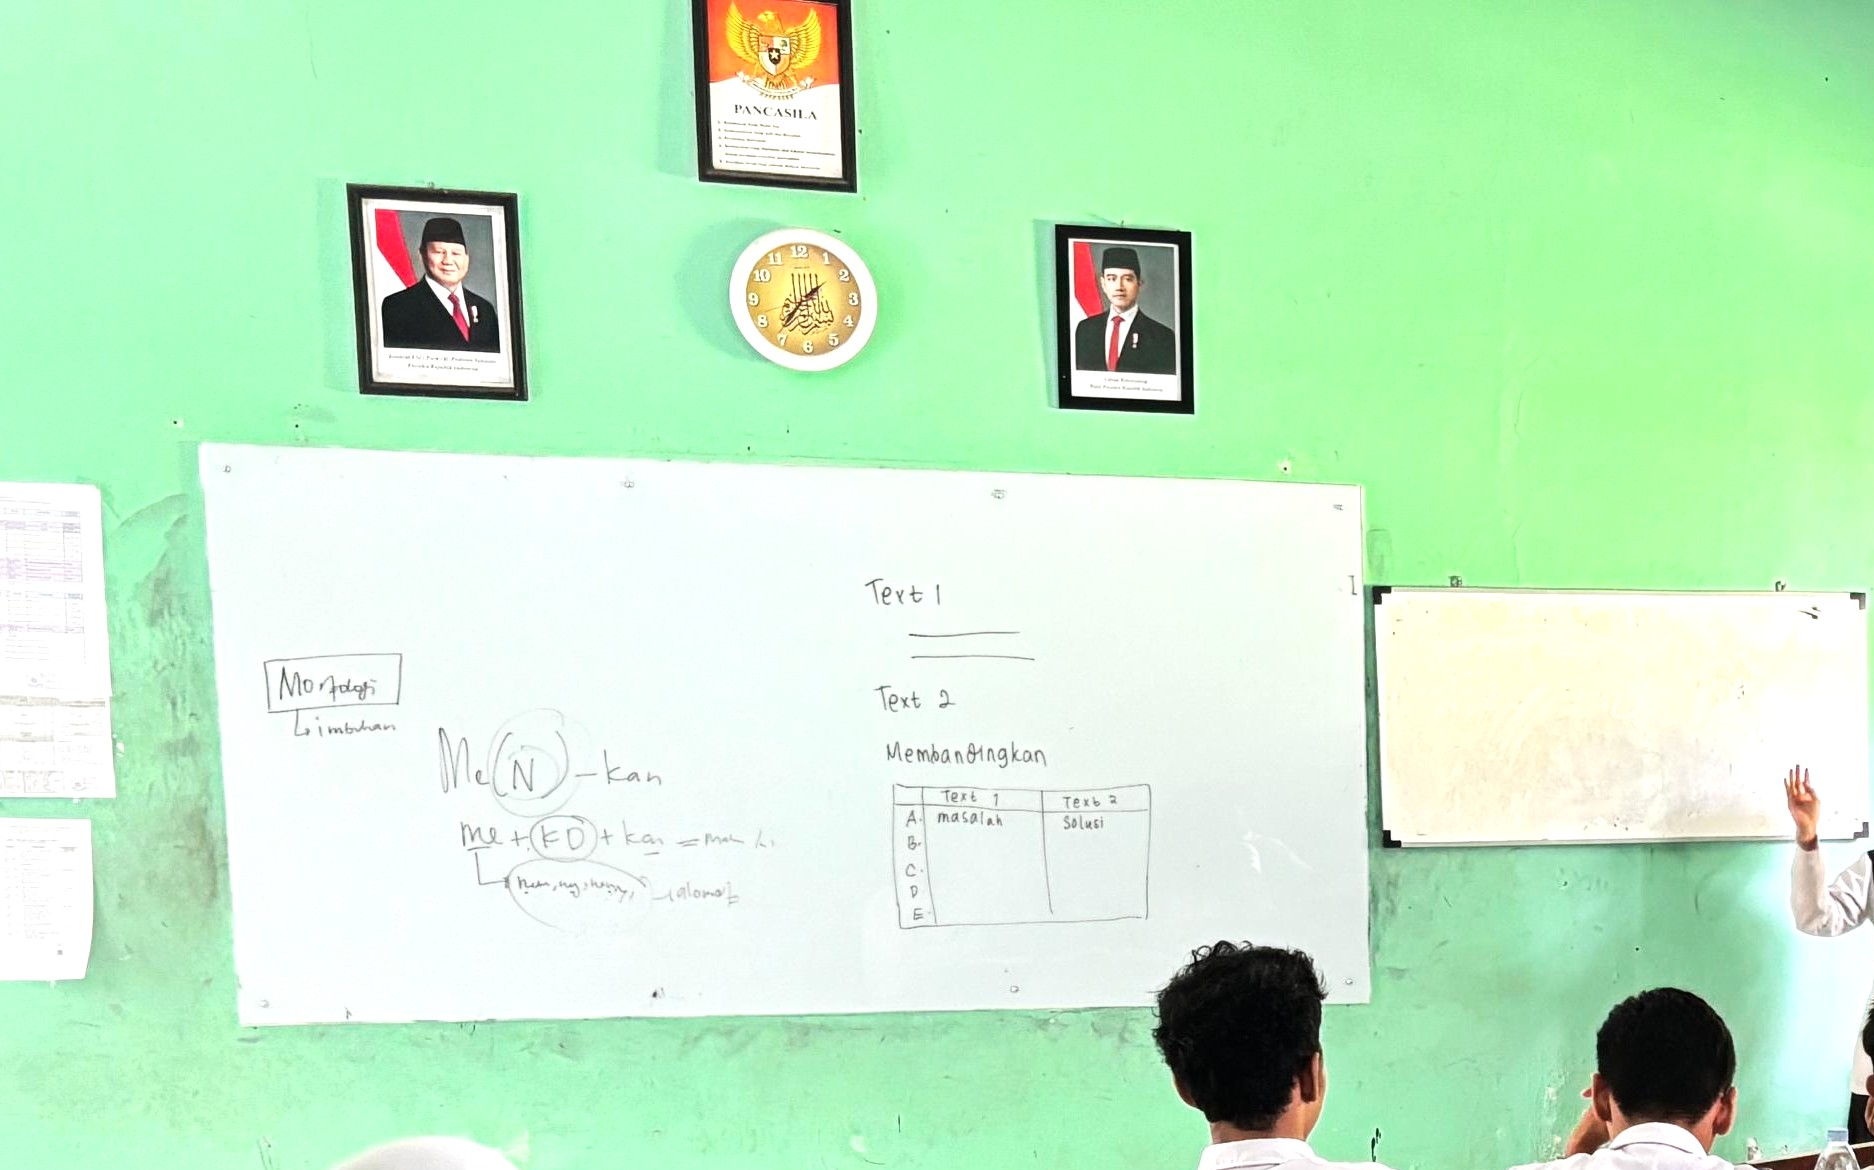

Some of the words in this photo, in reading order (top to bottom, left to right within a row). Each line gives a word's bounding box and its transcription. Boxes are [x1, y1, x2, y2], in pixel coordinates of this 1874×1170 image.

[734, 103, 818, 121] PANCASILA
[790, 245, 809, 258] 12
[768, 252, 783, 265] 11
[823, 252, 831, 265] 1
[753, 268, 771, 282] 10
[839, 269, 850, 281] 2
[748, 293, 759, 306] 9
[849, 292, 859, 305] 3
[757, 315, 768, 327] 8
[843, 315, 854, 327] 4
[777, 333, 787, 346] 7
[828, 333, 839, 346] 5
[803, 340, 814, 353] 6
[864, 577, 924, 606] Text
[935, 583, 942, 606] 1
[873, 684, 922, 713] Text
[938, 688, 956, 709] 2
[886, 740, 1048, 769] Membandingkan
[940, 789, 979, 804] Text
[1061, 794, 1102, 809] Text
[1109, 794, 1119, 806] 2
[937, 810, 1004, 828] masalah
